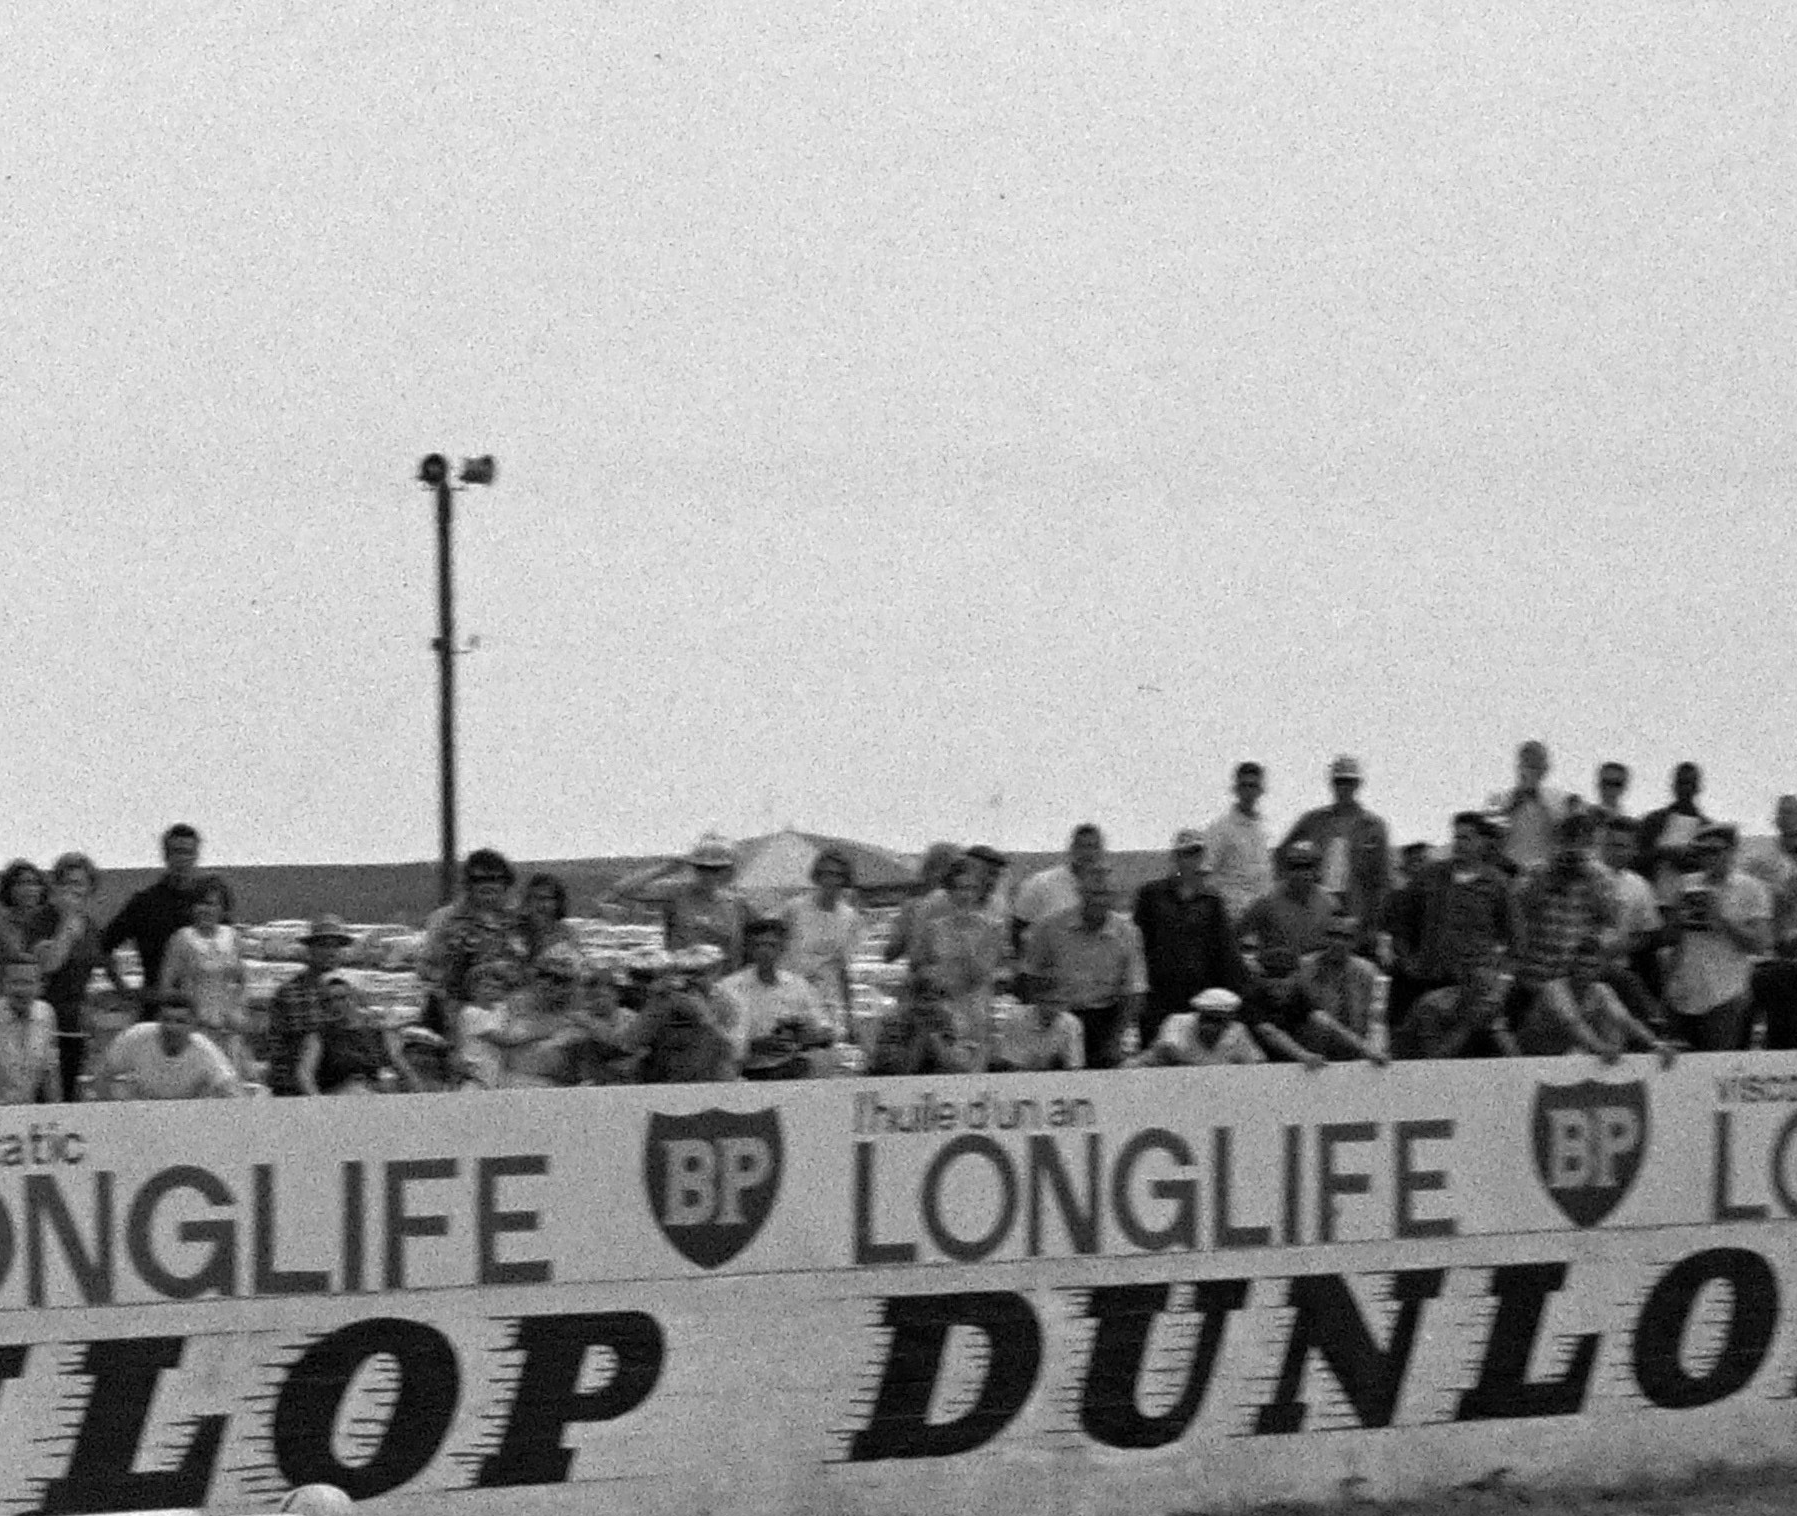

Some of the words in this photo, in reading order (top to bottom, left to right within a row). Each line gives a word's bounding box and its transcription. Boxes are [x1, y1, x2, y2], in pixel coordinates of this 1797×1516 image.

[661, 1136, 774, 1227] BP
[853, 1118, 1460, 1265] LONGLIFE
[1543, 1105, 1641, 1191] BP
